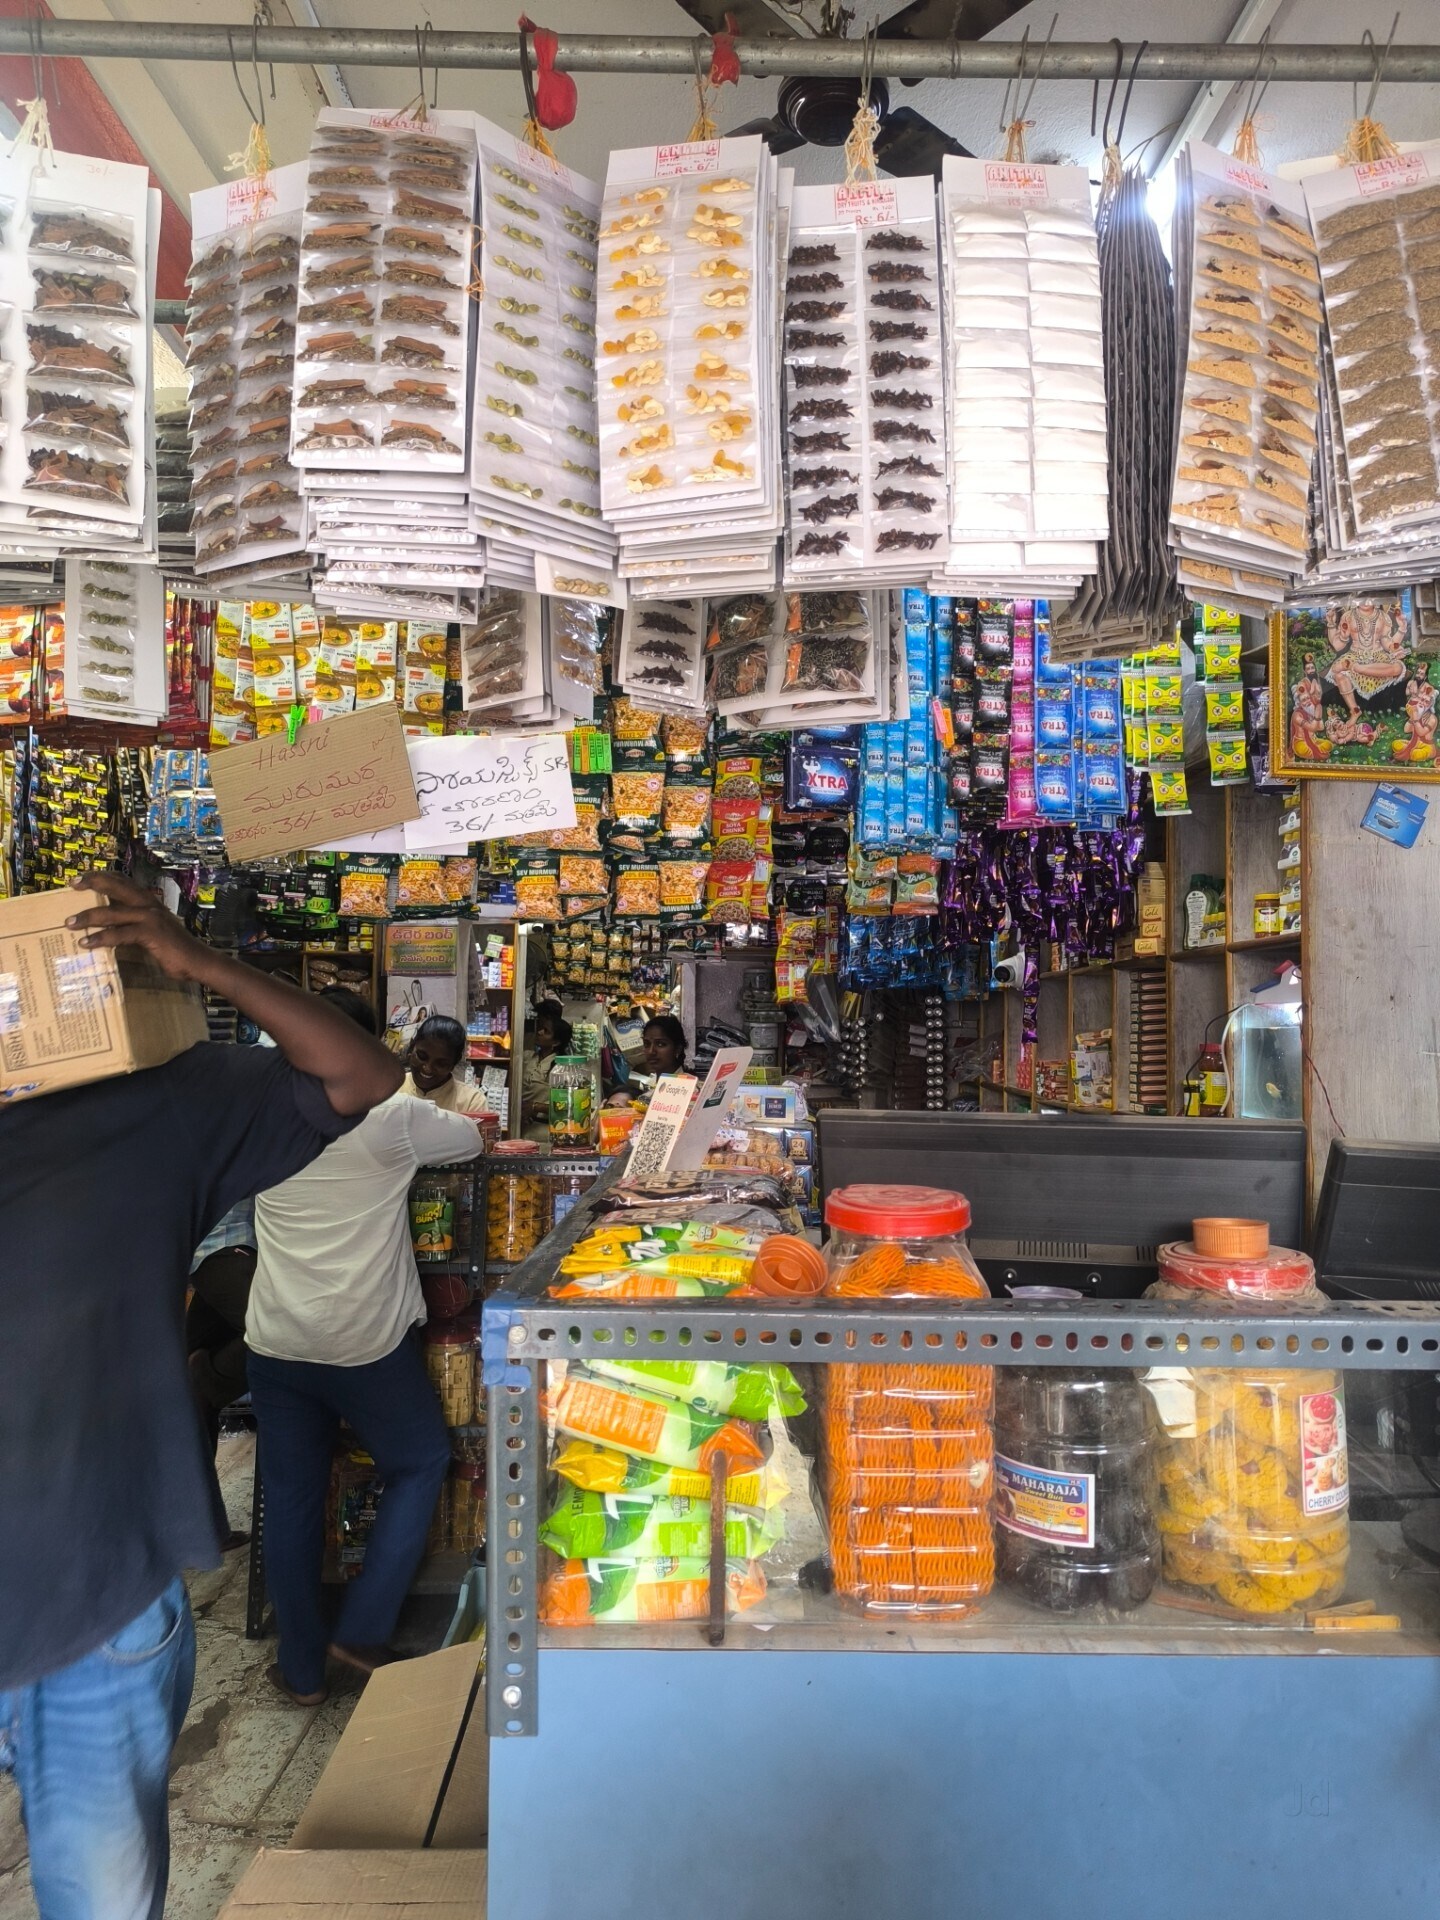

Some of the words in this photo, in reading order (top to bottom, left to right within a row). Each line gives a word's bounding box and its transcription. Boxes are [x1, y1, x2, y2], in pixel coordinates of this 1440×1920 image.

[988, 166, 1044, 182] ANITHA
[877, 211, 895, 223] 6/-
[980, 633, 1009, 645] XTRA
[978, 700, 1007, 710] XTRA
[1090, 710, 1114, 720] XTRA
[1042, 721, 1067, 731] XTRA
[976, 766, 1004, 778] XTRA
[807, 772, 848, 790] XTRA
[1090, 776, 1116, 786] XTRA
[1042, 786, 1067, 796] XTRA
[358, 866, 391, 874] MURMURA
[861, 879, 880, 888] TANG
[907, 872, 927, 884] TANG
[664, 896, 682, 904] EXTRA
[792, 1141, 803, 1149] 24
[1012, 1473, 1079, 1497] MAHARAJA
[1024, 1486, 1046, 1498] Sweet
[1047, 1491, 1064, 1502] Bun
[1308, 1493, 1335, 1509] CHERRY
